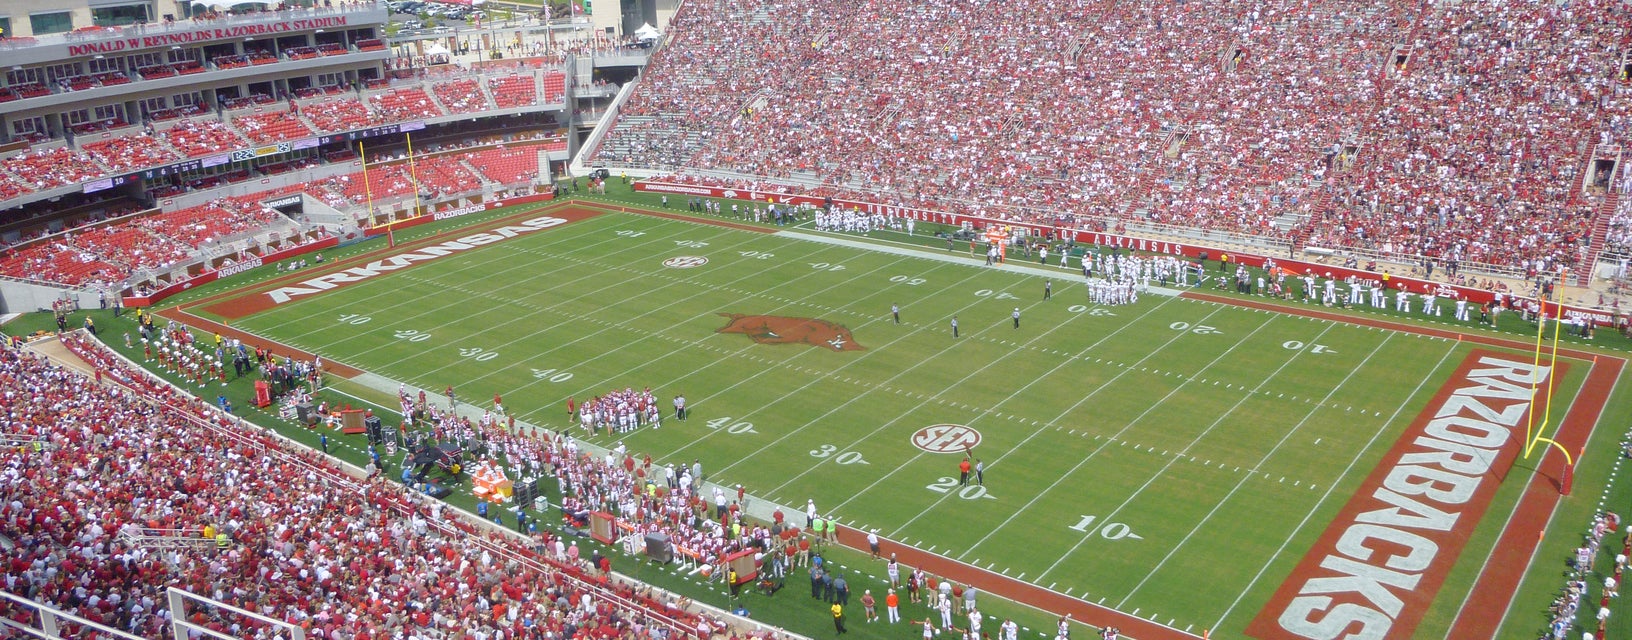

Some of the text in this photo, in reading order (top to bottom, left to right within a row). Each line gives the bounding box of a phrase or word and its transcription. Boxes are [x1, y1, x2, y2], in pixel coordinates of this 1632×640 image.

[67, 16, 347, 56] DONALD W REYNOLDS RAZORBACK STADIUM
[115, 177, 124, 185] 10
[265, 196, 300, 209] ARKANSAS
[433, 204, 486, 221] RAZORBACKS
[217, 257, 263, 279] ARKANSAS
[264, 216, 568, 304] ARKANSAS
[706, 416, 754, 434] 40
[916, 425, 976, 451] SEC
[809, 444, 863, 465] 30
[926, 476, 987, 500] 20
[1278, 356, 1552, 640] RAZORBACKS
[1068, 514, 1131, 540] 10
